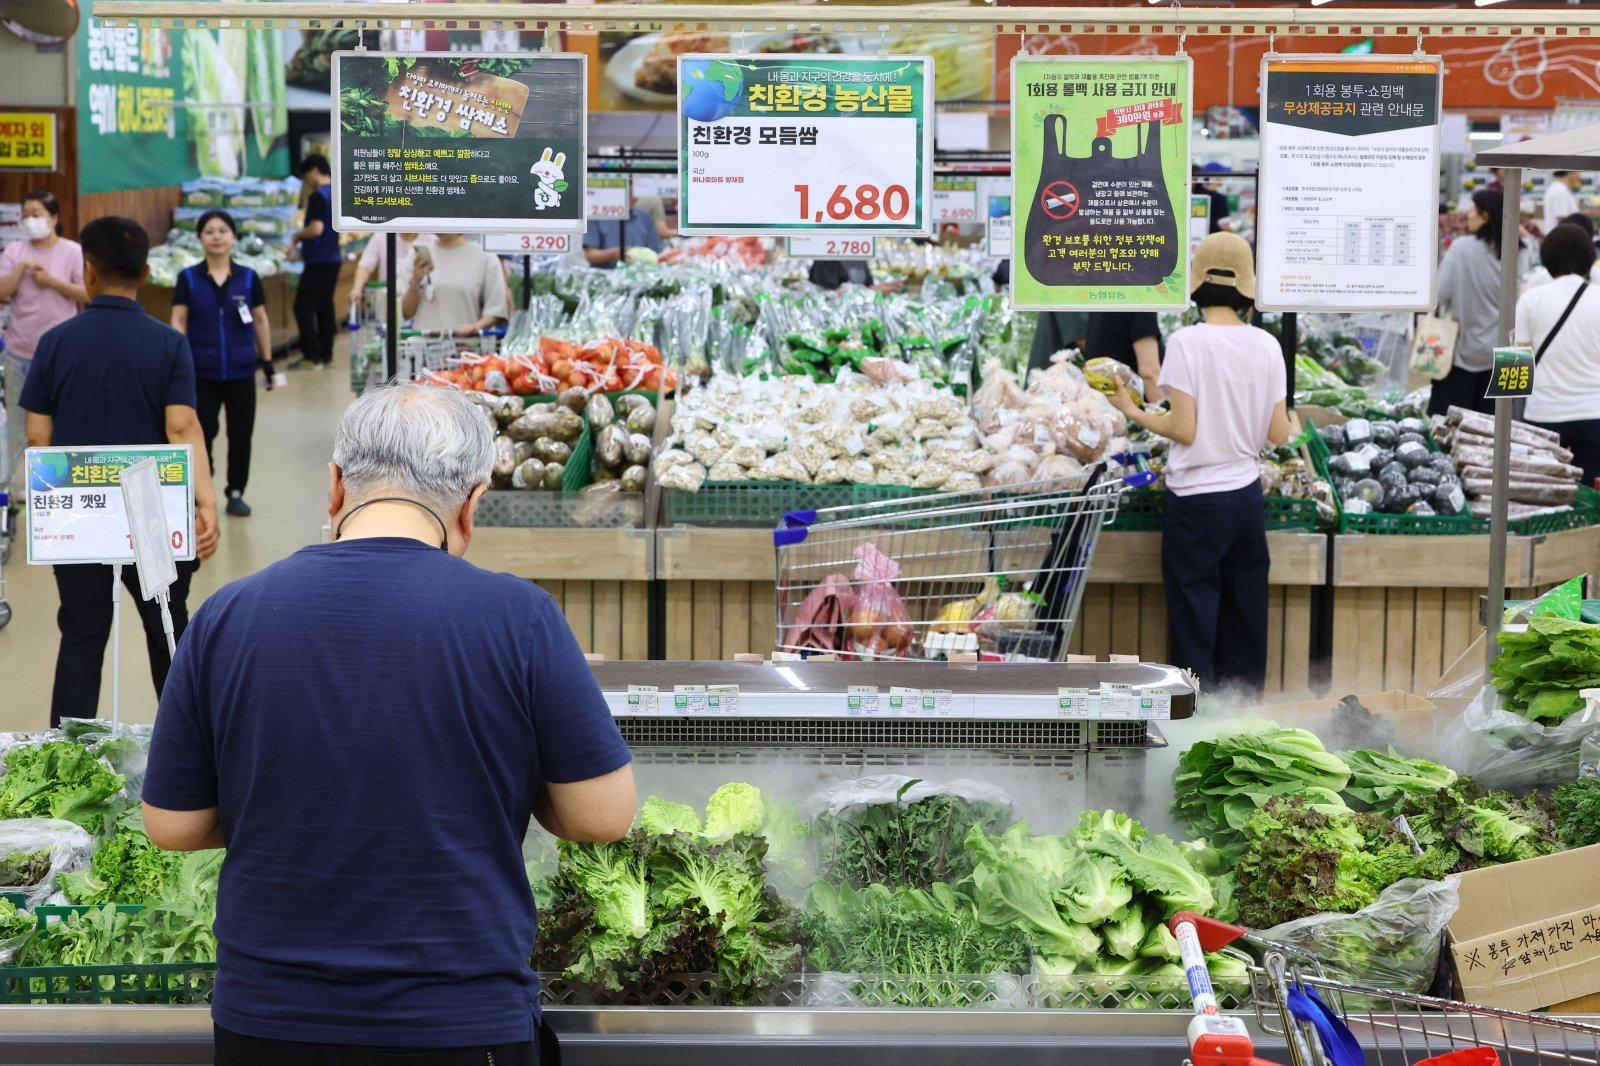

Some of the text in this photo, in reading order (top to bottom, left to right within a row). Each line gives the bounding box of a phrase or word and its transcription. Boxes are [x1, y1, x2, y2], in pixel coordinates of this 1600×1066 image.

[768, 72, 897, 83] 내 몸과 지구의 건강을 동시에!
[1026, 82, 1176, 97] 1회용 롤백 사용 금지 안내
[1306, 84, 1404, 98] 1회용 봉투·쇼핑백
[749, 84, 913, 113] 친환경 농산물
[398, 85, 509, 135] 친환경 쌈채소
[491, 99, 513, 114] 신선한
[1284, 101, 1424, 117] 무상제공금지 관련 안내문
[1116, 110, 1150, 124] 300만원
[31, 122, 45, 137] 외
[692, 126, 818, 145] 친환경 모듬쌈
[16, 142, 45, 158] 금지
[354, 149, 490, 158] 회원님들이 정말 싱싱하고 예쁘고 깔끔하다고
[692, 150, 710, 159] 100g
[353, 162, 366, 170] 좋은
[368, 162, 381, 170] 평을
[383, 162, 402, 170] 해주신
[353, 174, 379, 184] 고기맛도
[381, 174, 388, 184] 더
[404, 174, 438, 184] 샤브샤브도
[440, 174, 447, 184] 더
[449, 174, 468, 184] 맛있고
[470, 174, 496, 184] 즙으로도
[692, 176, 744, 184] 하나로마트 양재점
[354, 186, 466, 194] 건강하게 키워 더 신선한 친환경 쌈채소
[1095, 190, 1148, 198] 냉장고 등에 보관하는
[376, 196, 413, 206] 드셔보세요.
[794, 184, 910, 223] 1,680
[1078, 208, 1165, 216] 발생하는 제품 등 일부 상품을 담는
[1090, 218, 1156, 226] 용도로만 사용 가능합니다.
[521, 236, 566, 251] 3,290
[1042, 234, 1165, 245] 환경 보호를 위한 정부 정책에
[826, 241, 870, 256] 2,780
[1048, 248, 1159, 258] 고객 여러분의 협조와 양해
[1072, 262, 1134, 272] 부탁 드립니다.
[1089, 291, 1126, 300] 농협유통
[1498, 366, 1529, 390] 작업중
[84, 456, 92, 464] 내
[72, 464, 124, 484] 친환경
[34, 494, 106, 510] 친환경 깻잎
[1488, 939, 1512, 960] 봉투
[1582, 914, 1600, 930] 마
